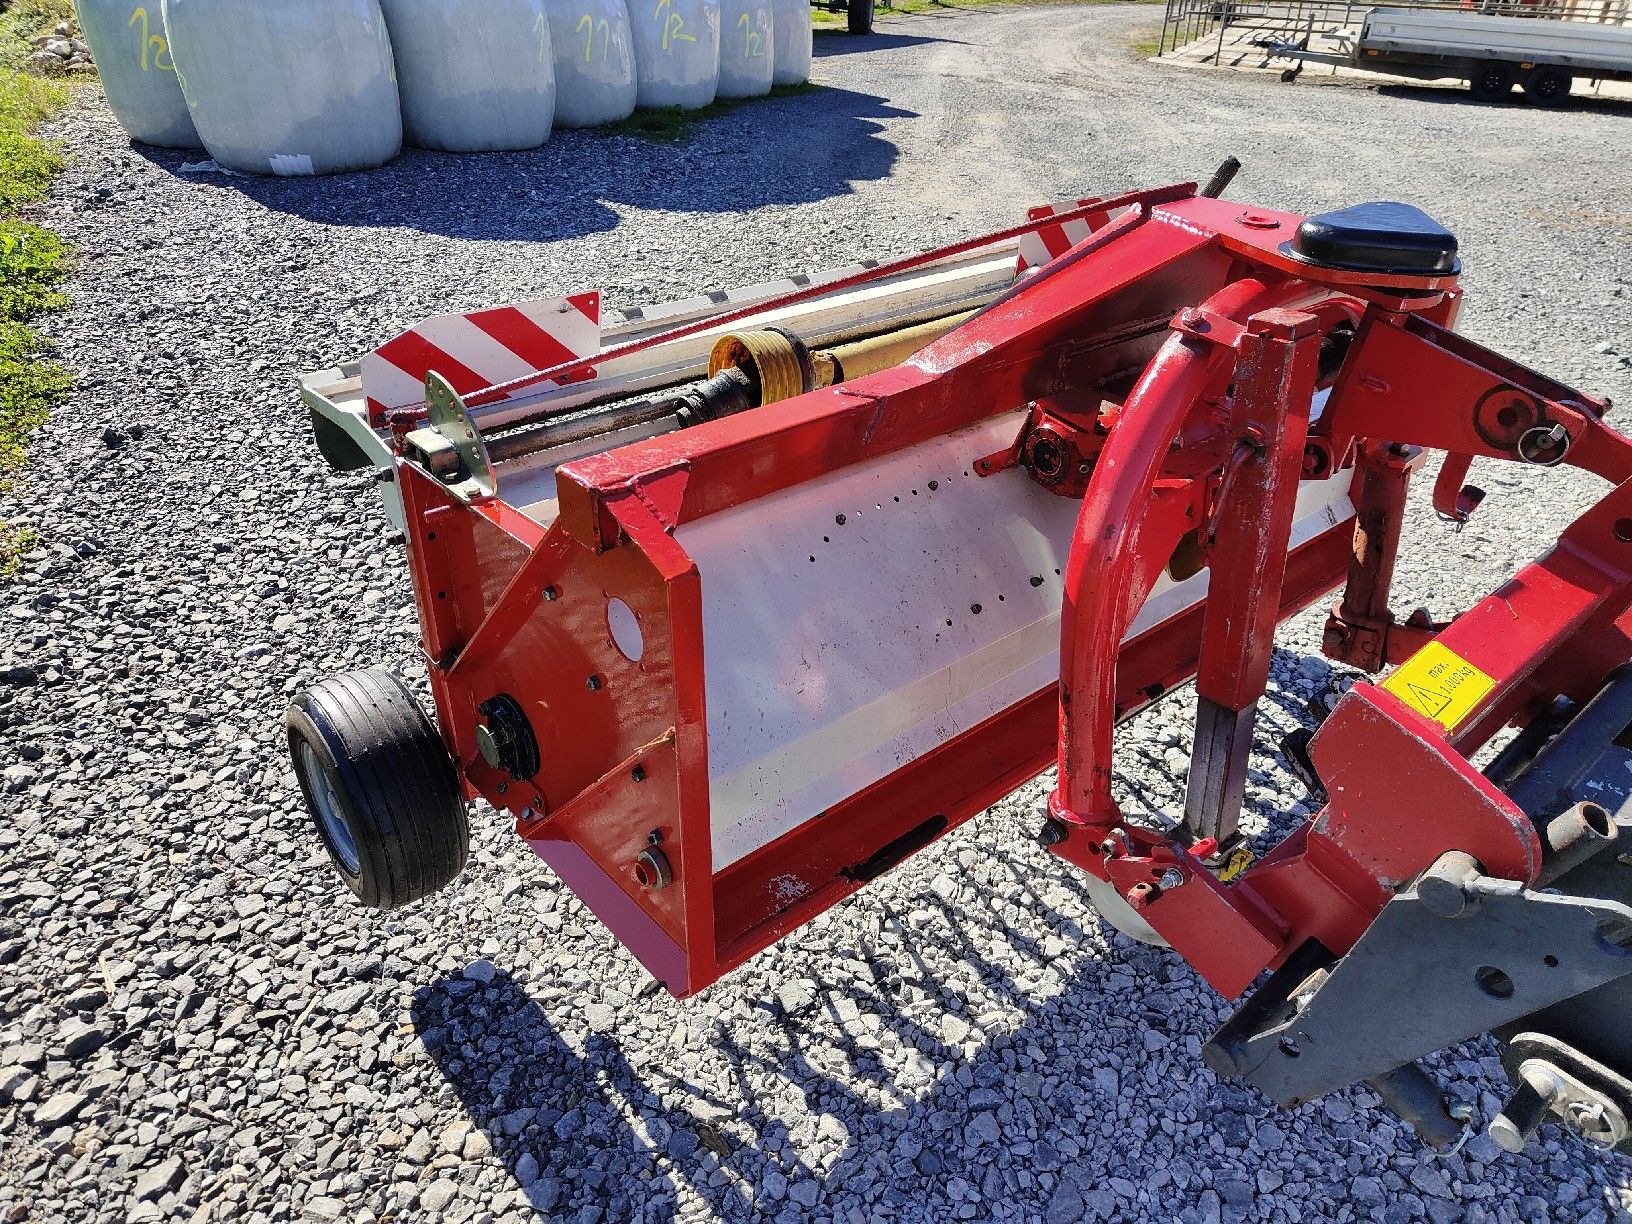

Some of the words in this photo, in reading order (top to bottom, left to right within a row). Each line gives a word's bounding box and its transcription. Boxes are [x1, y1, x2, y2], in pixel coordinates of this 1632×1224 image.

[129, 8, 175, 71] 12
[576, 15, 610, 63] 11
[655, 0, 697, 49] 12
[737, 13, 763, 58] 12
[1428, 663, 1450, 678] max.
